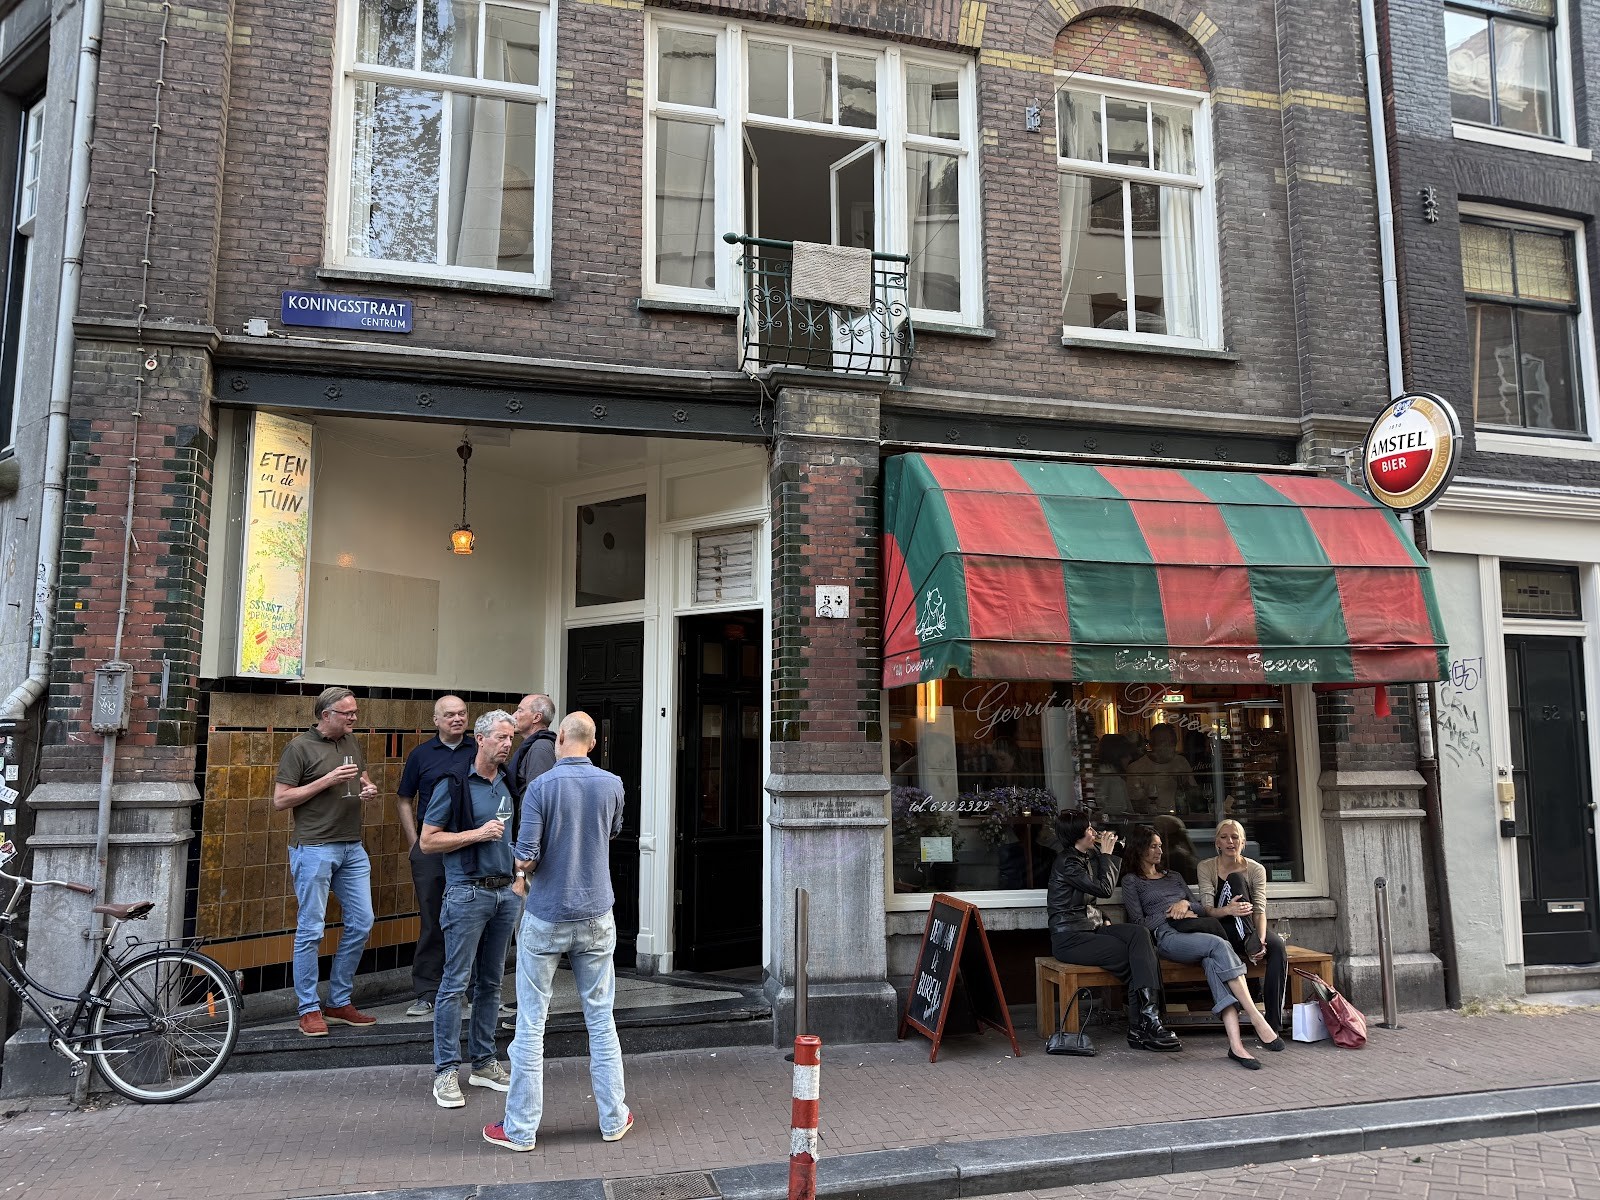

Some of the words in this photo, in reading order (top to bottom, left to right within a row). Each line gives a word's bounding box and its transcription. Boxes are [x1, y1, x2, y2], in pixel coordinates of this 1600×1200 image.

[287, 295, 406, 317] KONINGSSTRAAT
[360, 317, 406, 329] CENTRUM
[1370, 430, 1427, 459] AMSTEL
[259, 451, 308, 477] ETEN
[1381, 456, 1407, 473] BIER
[280, 474, 295, 487] de
[258, 489, 304, 513] TUIN
[1401, 484, 1433, 505] TRADITIE
[1209, 658, 1240, 673] van
[1247, 652, 1318, 673] Beeren
[962, 681, 1058, 739] Gerrit
[1543, 704, 1560, 720] 52
[908, 795, 933, 812] tel.
